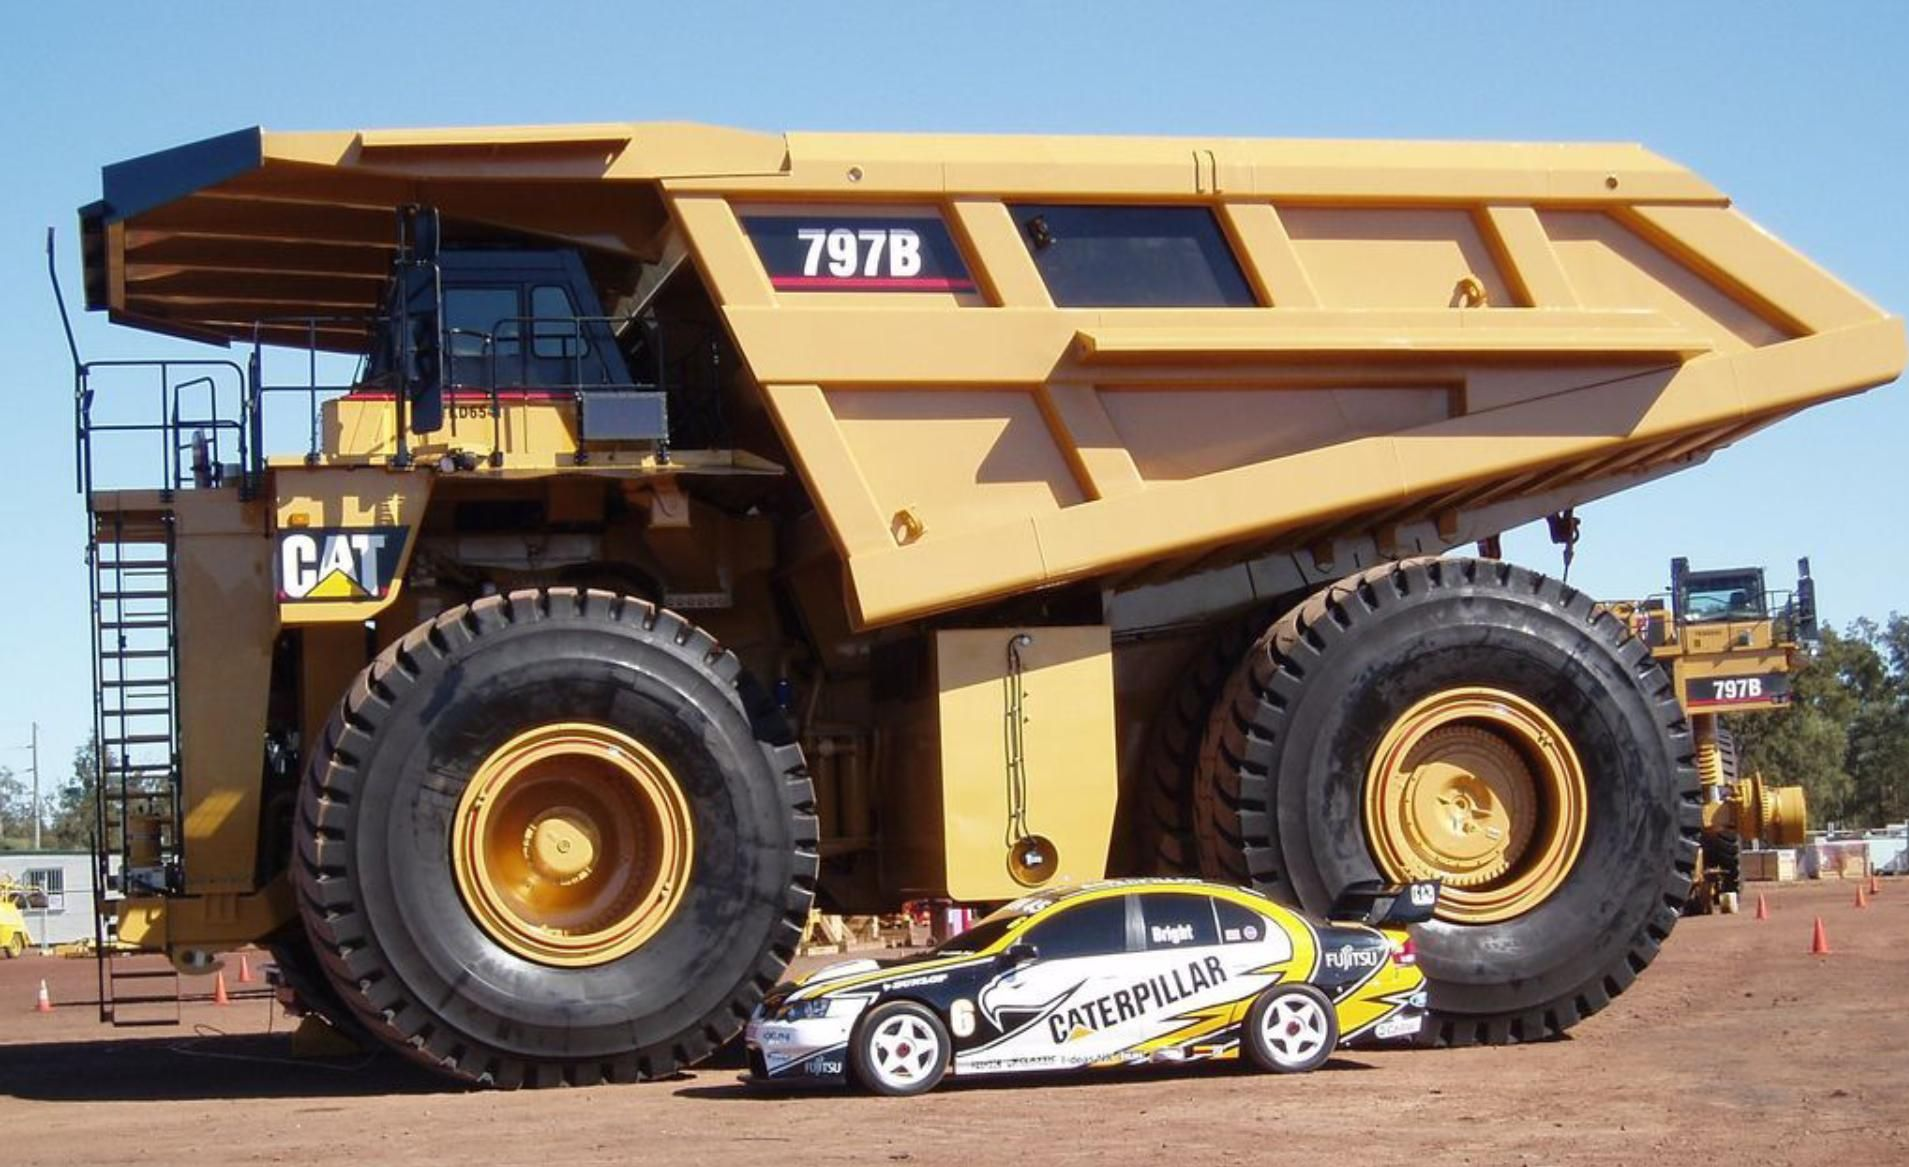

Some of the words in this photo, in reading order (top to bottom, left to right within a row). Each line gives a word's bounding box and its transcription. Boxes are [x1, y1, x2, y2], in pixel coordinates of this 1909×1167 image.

[797, 227, 922, 278] 797B
[282, 533, 386, 599] CAT
[1712, 677, 1763, 701] 797B
[1151, 923, 1195, 945] Bright
[1324, 944, 1378, 972] FUJITSU
[1047, 954, 1228, 1046] CATERPILLAR
[950, 998, 976, 1038] 6
[804, 1055, 843, 1076] FUJITSU
